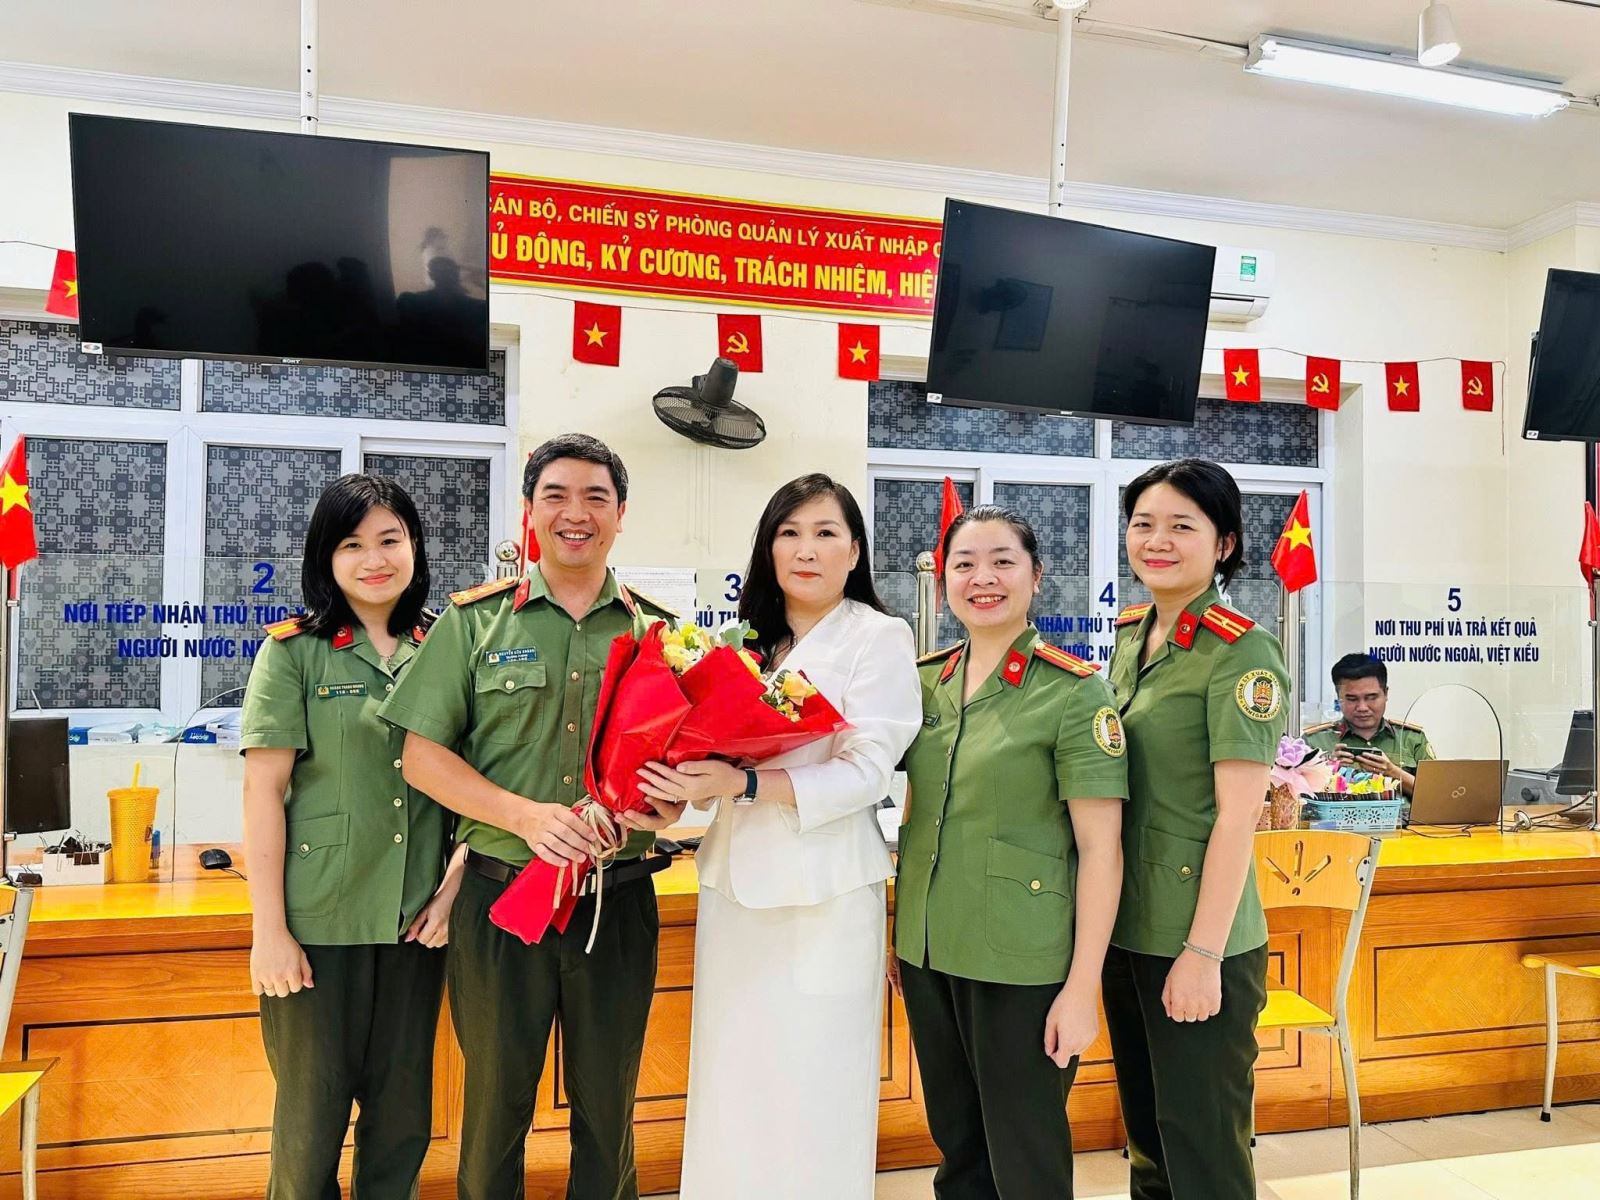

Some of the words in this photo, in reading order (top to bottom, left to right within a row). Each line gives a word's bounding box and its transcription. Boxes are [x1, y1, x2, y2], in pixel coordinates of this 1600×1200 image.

[490, 192, 523, 216] ÁN
[529, 197, 563, 225] BỘ,
[568, 202, 629, 228] CHIẾN
[633, 208, 660, 231] SỸ
[665, 213, 733, 239] PHÒNG
[738, 219, 793, 246] QUẢN
[797, 226, 820, 247] LÝ
[825, 228, 876, 252] XUẤT
[880, 235, 929, 261] NHẬP
[515, 231, 594, 272] ĐỘNG,
[600, 234, 633, 272] KỶ
[639, 247, 728, 285] CƯƠNG,
[733, 255, 808, 288] TRÁCH
[814, 262, 894, 299] NHIỆM,
[899, 268, 938, 305] HIỆ
[252, 562, 275, 594] 2
[724, 573, 742, 602] 3
[1098, 582, 1116, 607] 4
[1447, 587, 1462, 612] 5
[64, 601, 98, 624] NƠI
[104, 598, 147, 624] TIẾP
[152, 600, 207, 629] NHẬN
[212, 599, 249, 625] THỦ
[1077, 611, 1102, 633] THỦ
[1375, 618, 1396, 636] NƠI
[1399, 620, 1421, 636] THU
[1425, 617, 1444, 636] PHÍ
[1447, 617, 1463, 636] VÀ
[1465, 615, 1487, 636] TRẢ
[1490, 616, 1511, 636] KẾT
[1514, 616, 1537, 638] QUẢ
[118, 634, 178, 658] NGƯỜI
[184, 634, 236, 658] NƯỚC
[1369, 642, 1405, 662] NGƯỜI
[1409, 643, 1441, 662] NƯỚC
[1444, 643, 1484, 664] NGOÀI,
[1486, 643, 1511, 666] VIỆT
